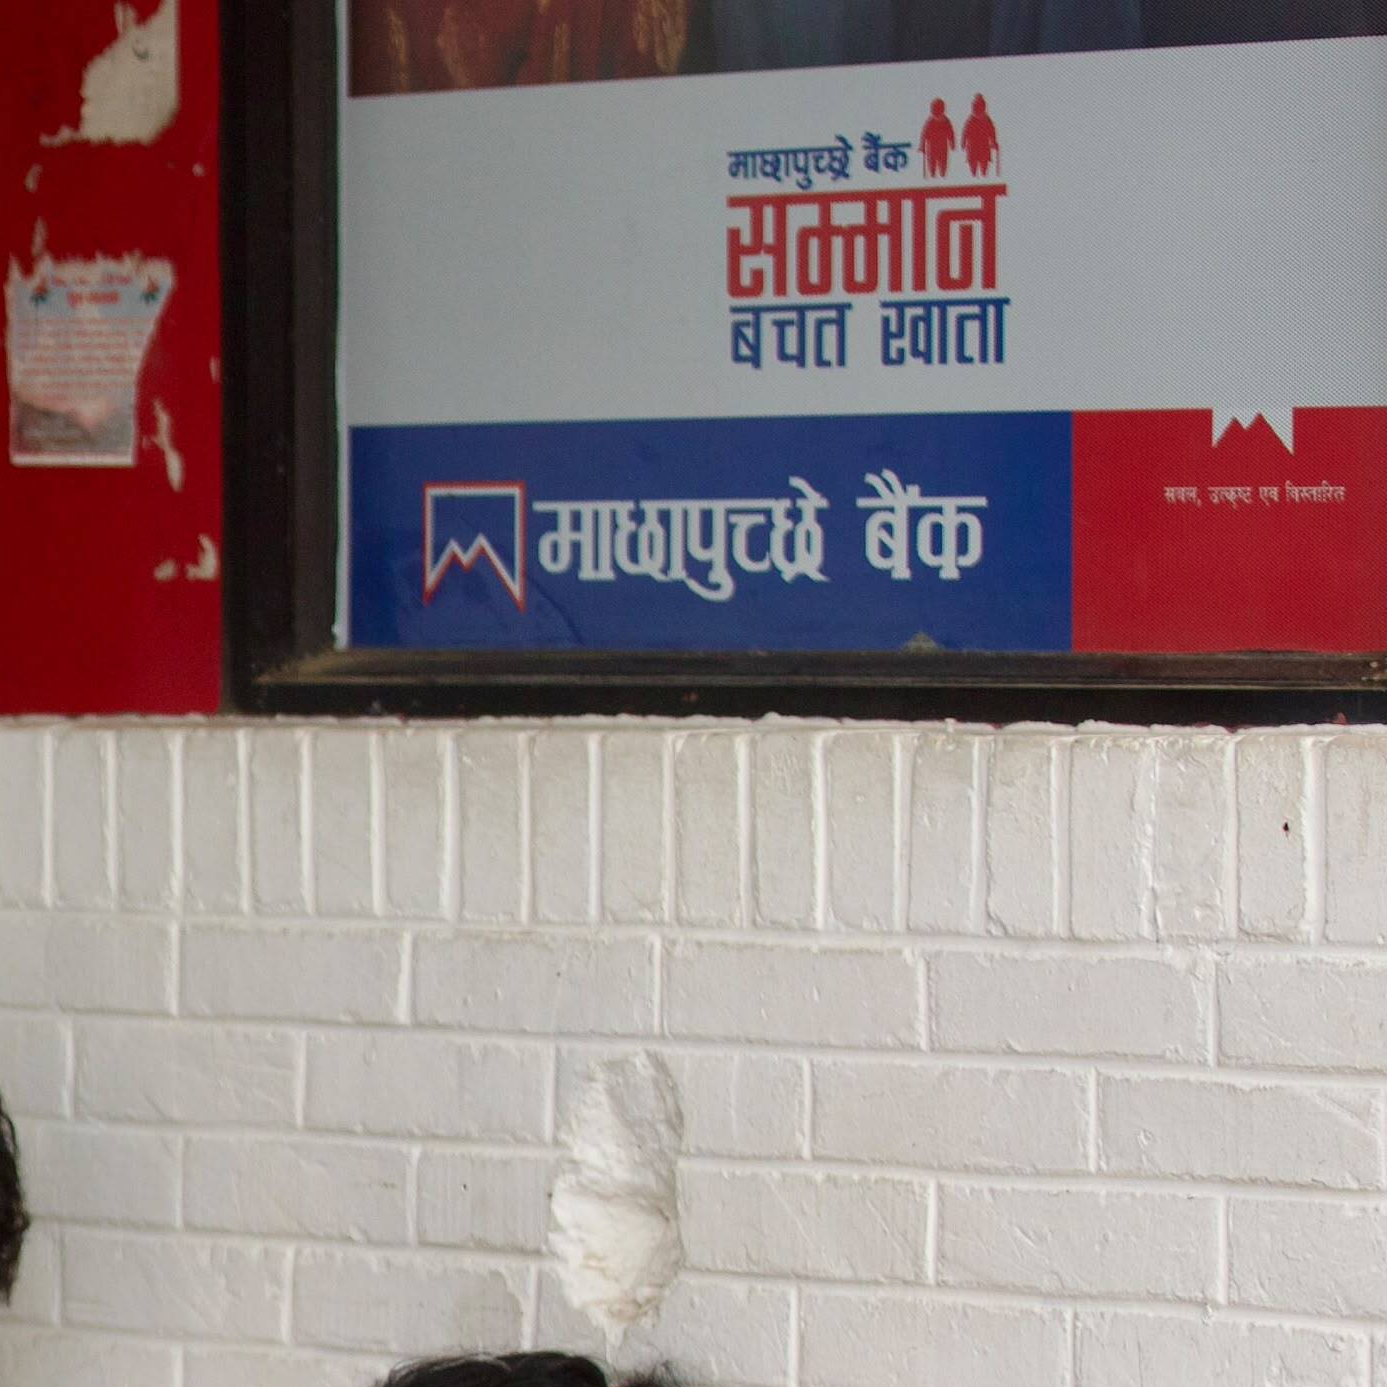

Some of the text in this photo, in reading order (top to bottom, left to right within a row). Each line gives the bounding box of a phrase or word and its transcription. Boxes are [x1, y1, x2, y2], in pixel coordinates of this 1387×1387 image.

[726, 184, 1008, 298] सम्मान
[729, 297, 1011, 369] बचत खाता
[856, 469, 988, 580] बैंक
